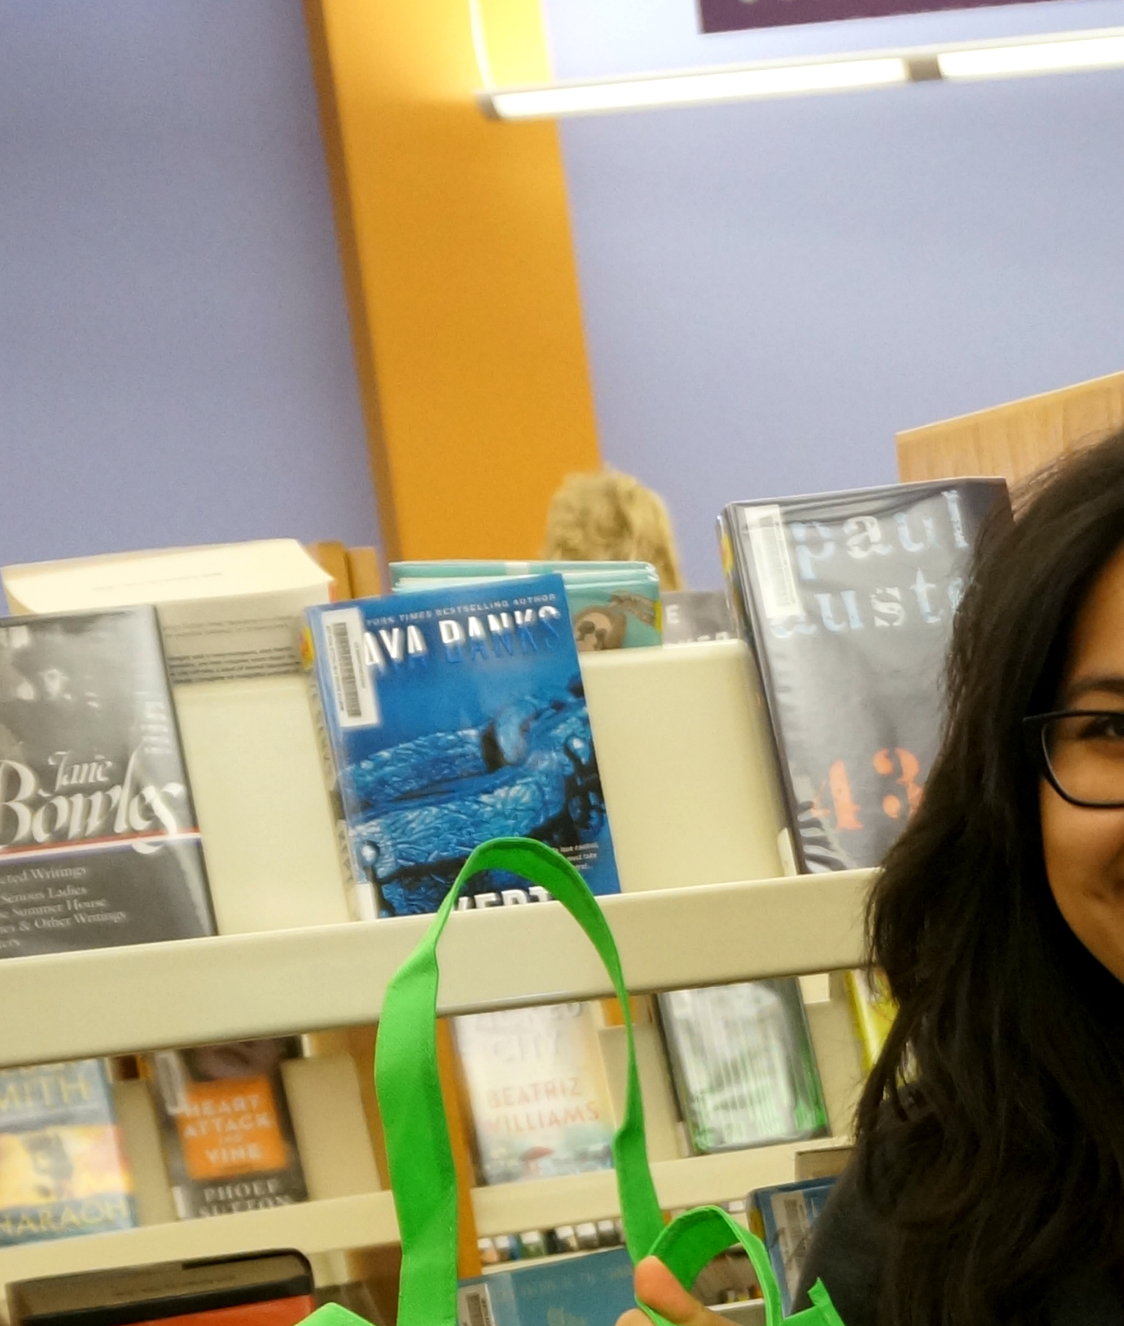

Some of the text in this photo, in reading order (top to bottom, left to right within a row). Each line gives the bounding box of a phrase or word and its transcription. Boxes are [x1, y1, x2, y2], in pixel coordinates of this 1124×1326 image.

[789, 489, 970, 580] paul
[399, 609, 432, 621] TIMES
[435, 600, 509, 618] BESTSELLING
[512, 593, 556, 606] AUTHOR
[38, 751, 113, 796] Jane
[47, 884, 88, 899] Ladies
[66, 897, 108, 911] House
[486, 1076, 583, 1109] BEATRIZ
[184, 1111, 273, 1138] ATTACK
[481, 1101, 600, 1134] WILLIAMS
[204, 1143, 263, 1165] VINE
[0, 1192, 128, 1236] HARAOH
